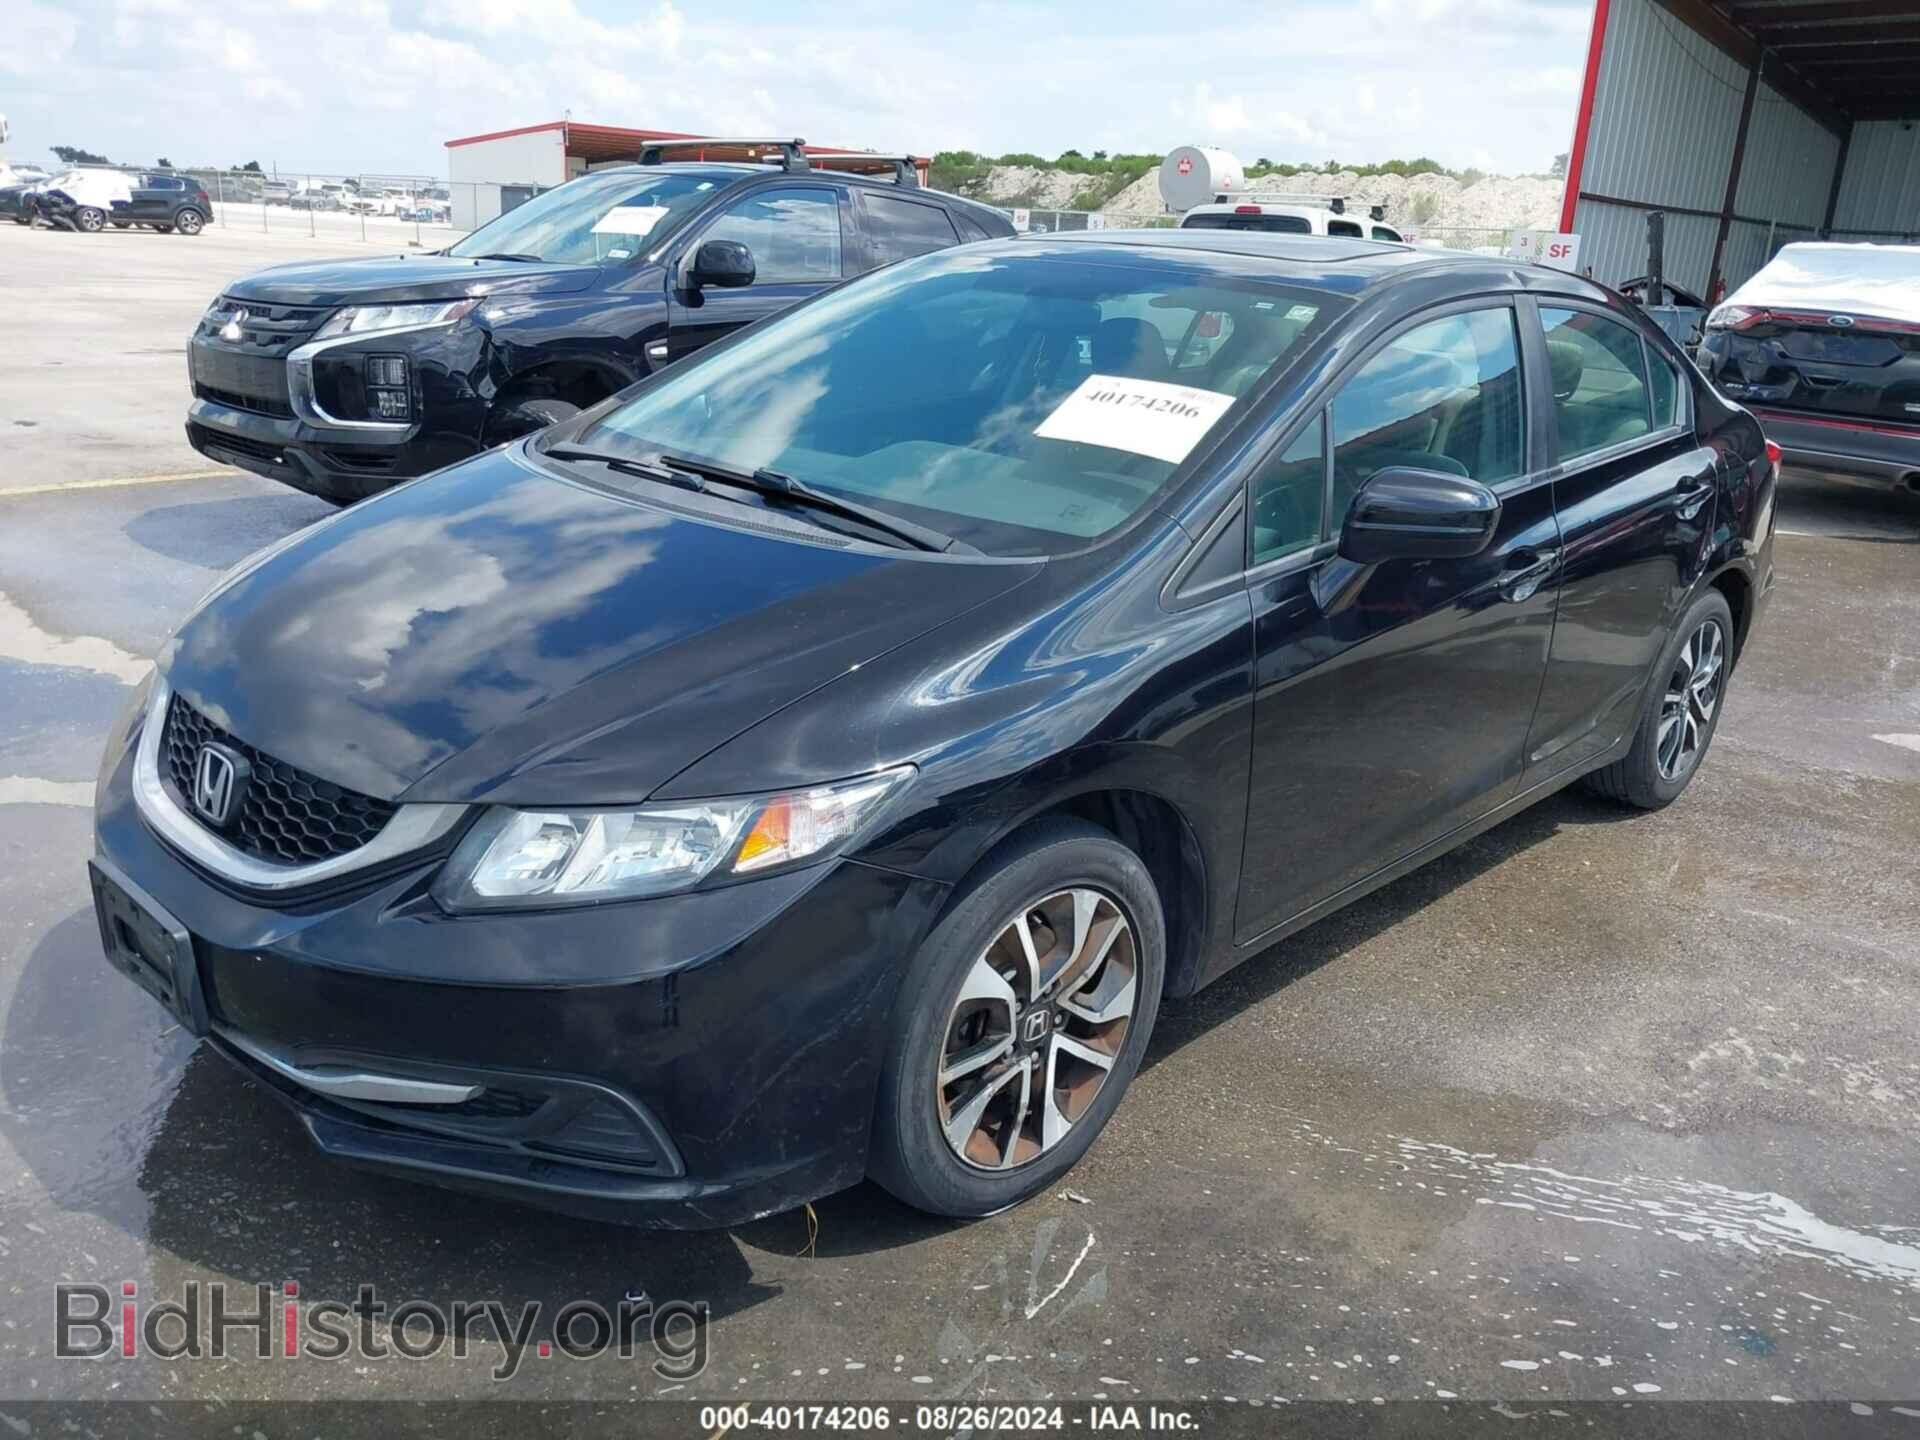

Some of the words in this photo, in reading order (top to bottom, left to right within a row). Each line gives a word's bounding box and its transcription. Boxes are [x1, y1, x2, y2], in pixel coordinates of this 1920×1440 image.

[1520, 236, 1528, 247] 3
[1549, 244, 1572, 258] SF
[1086, 390, 1201, 418] 40174206
